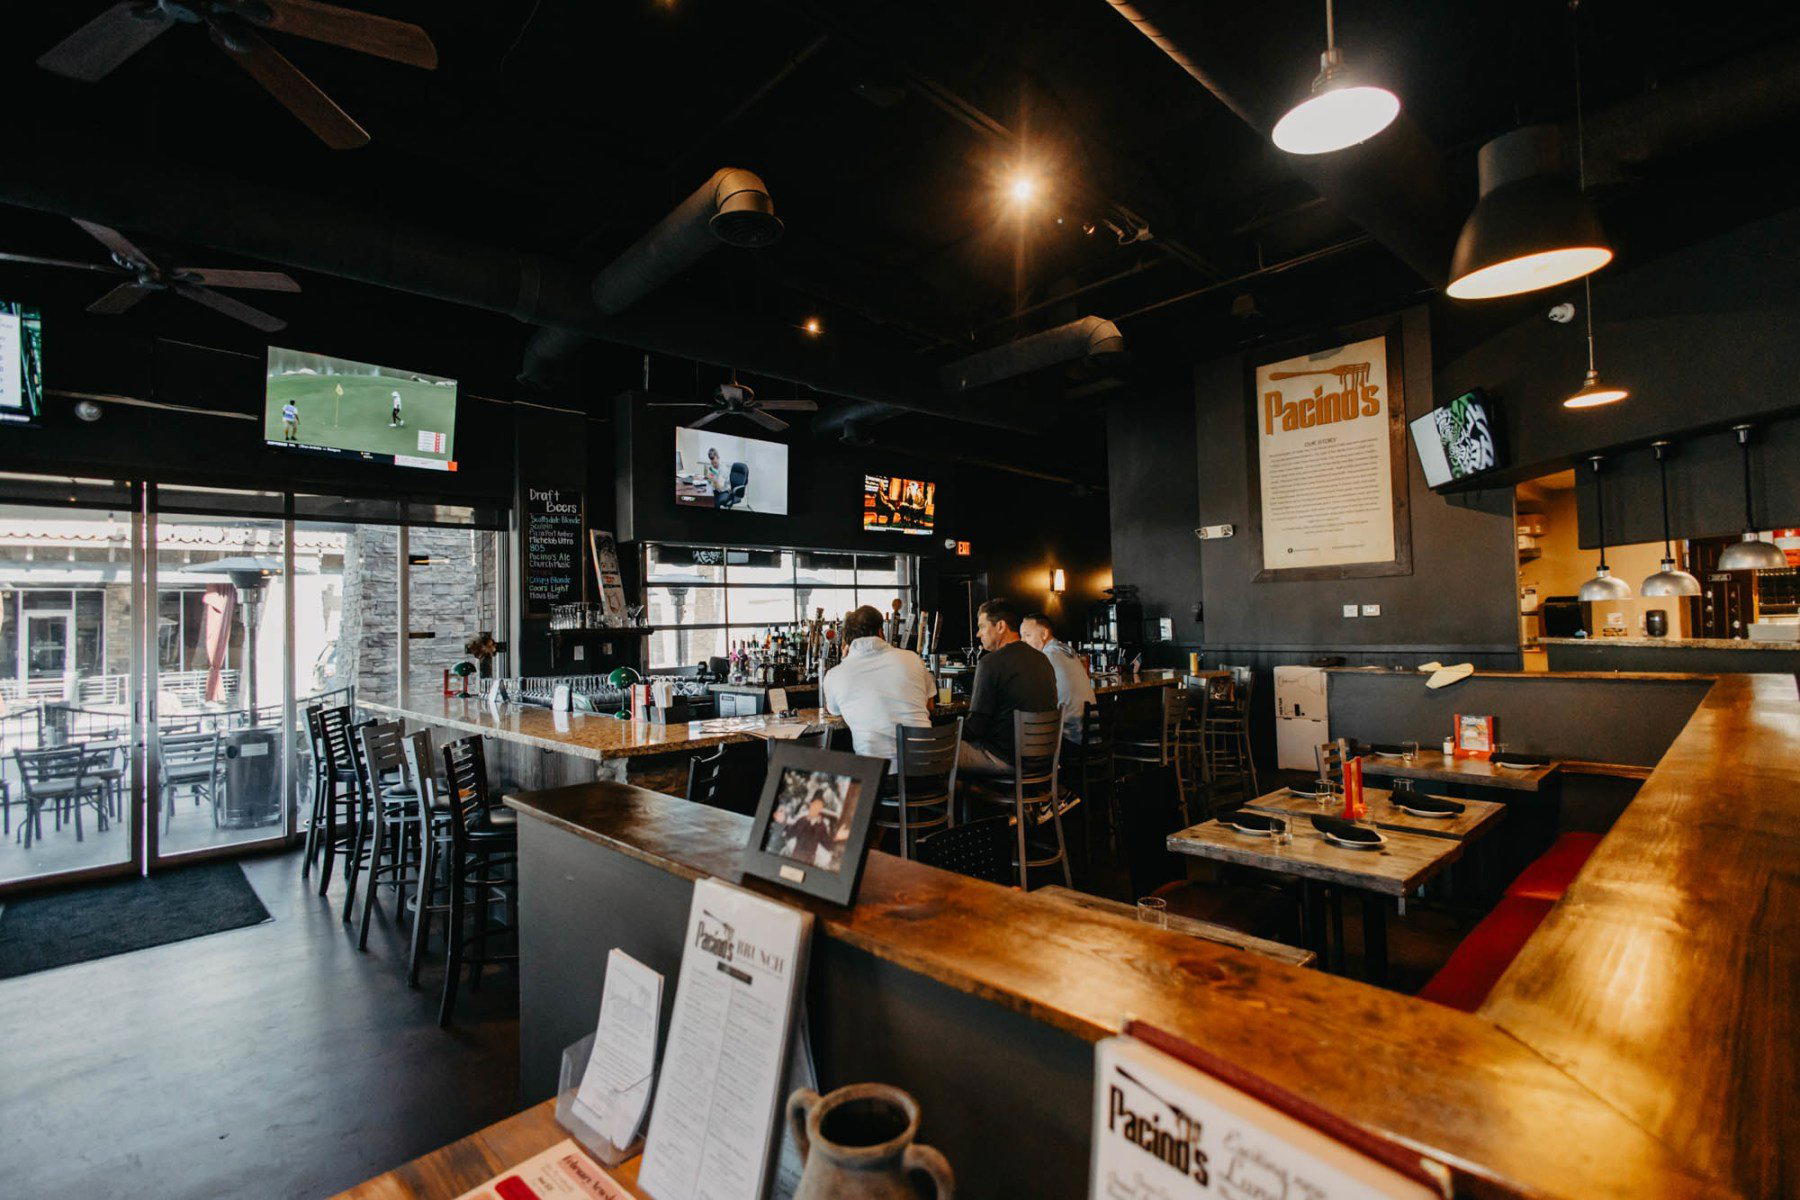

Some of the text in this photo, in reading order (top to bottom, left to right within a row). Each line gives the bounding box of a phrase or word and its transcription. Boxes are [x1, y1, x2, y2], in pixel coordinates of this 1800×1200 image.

[1264, 384, 1380, 436] Pacino's
[529, 488, 560, 501] Draft
[546, 501, 577, 513] Beers
[958, 541, 970, 555] EXIT
[695, 921, 735, 962] Pacino's
[1109, 1084, 1209, 1187] Pacino's
